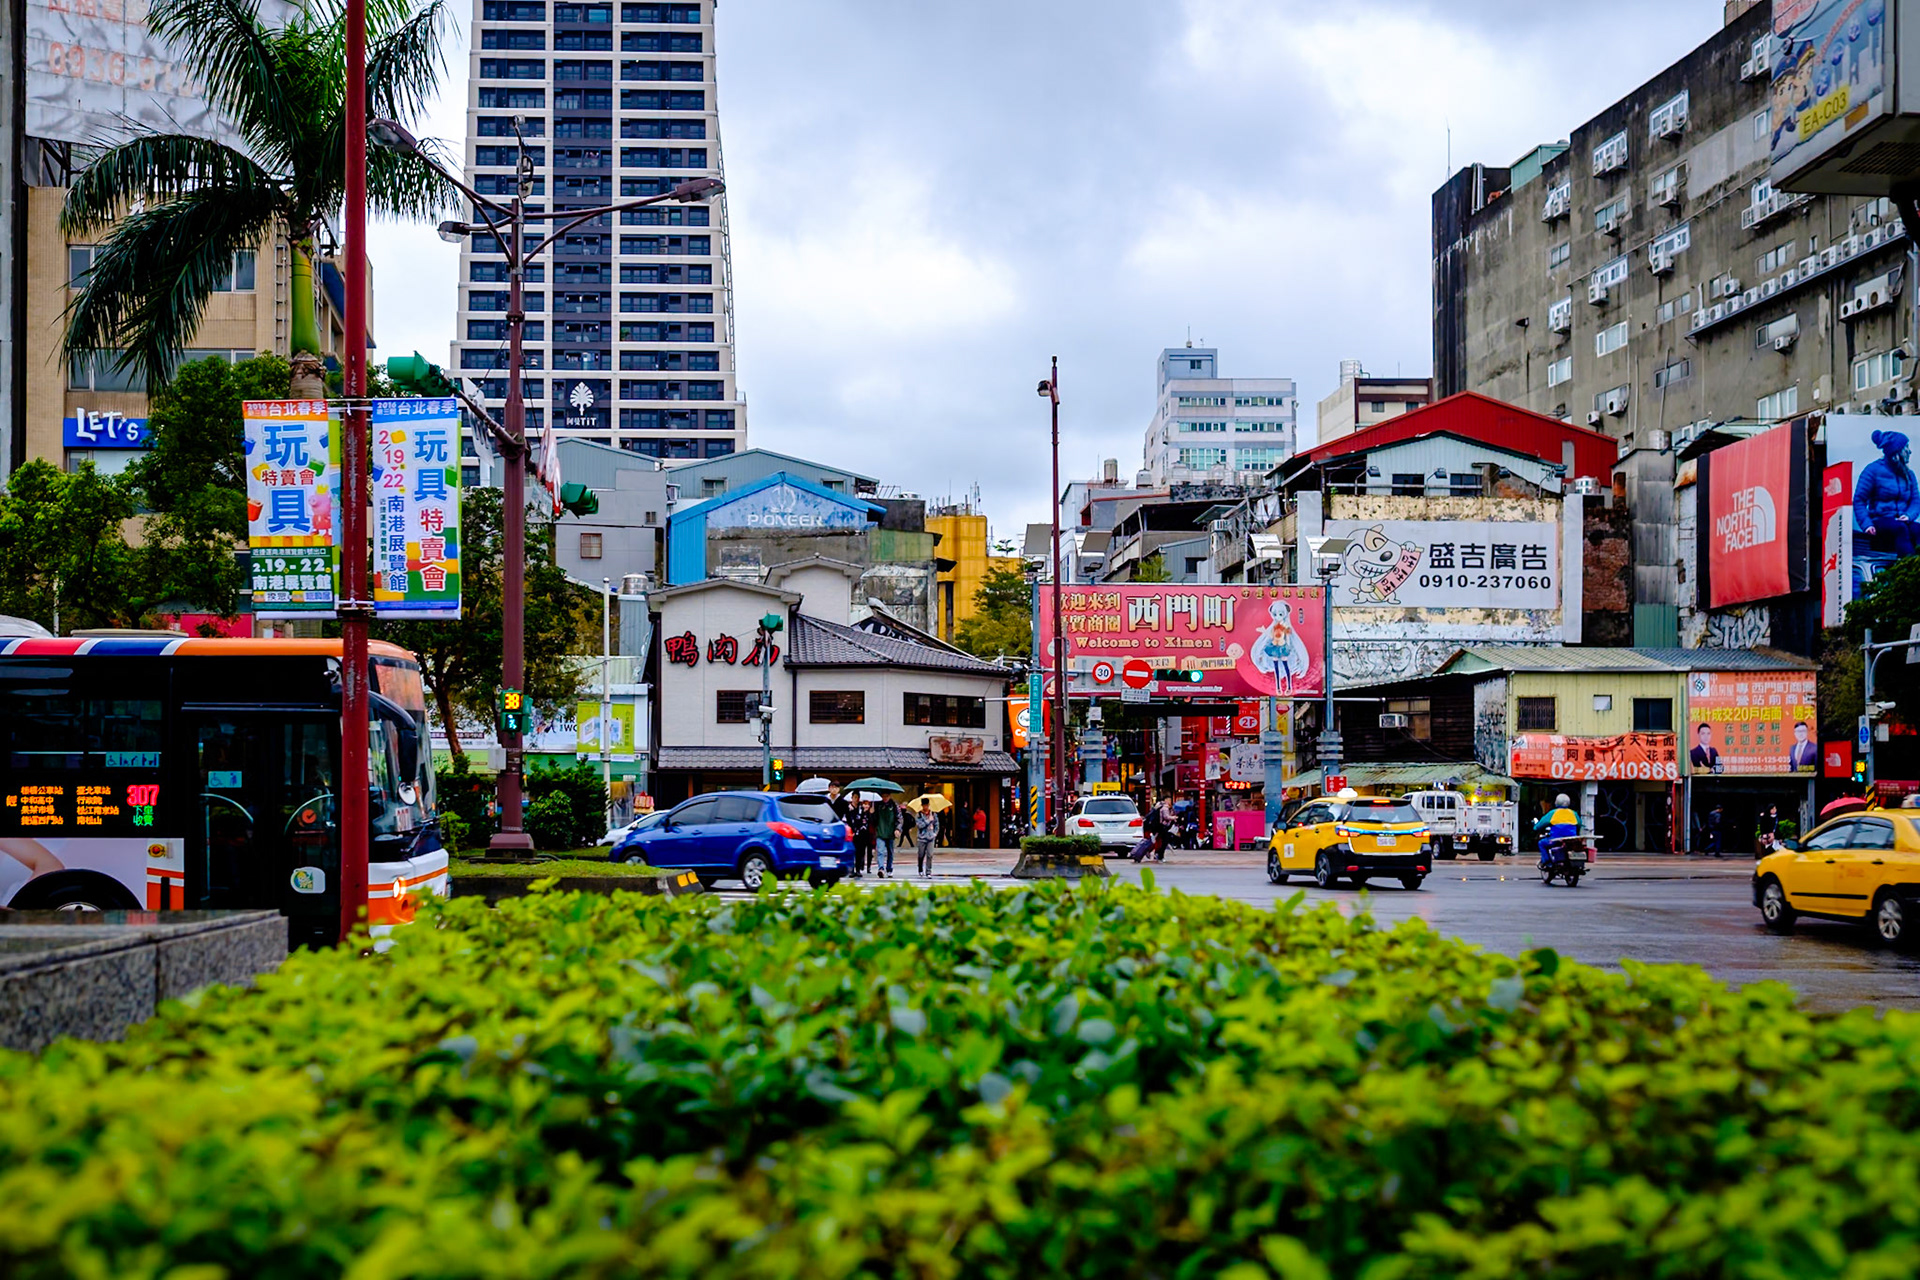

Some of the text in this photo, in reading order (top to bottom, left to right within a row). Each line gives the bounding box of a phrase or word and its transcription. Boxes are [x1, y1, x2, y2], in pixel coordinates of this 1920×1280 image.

[1803, 91, 1847, 135] EA-C03
[269, 401, 326, 417] 台北春季
[398, 400, 456, 416] 台北春季
[264, 424, 309, 468] 玩
[261, 469, 315, 486] 特賣會
[383, 474, 404, 488] 22
[1732, 488, 1754, 511] THE
[267, 489, 311, 533] 具
[747, 513, 825, 527] PIONEER
[1716, 508, 1752, 537] NORTH
[387, 495, 408, 592] 南港展覽館
[1724, 529, 1753, 554] FACE
[1428, 543, 1547, 571] 盛吉廣告
[252, 575, 332, 590] 南港展覽館
[1419, 574, 1551, 590] 0910-237060
[1126, 593, 1237, 632] 西門町
[1075, 636, 1139, 648] Welcome
[1145, 637, 1159, 648] to
[1164, 637, 1212, 648] Ximen
[1097, 668, 1110, 678] 30
[504, 692, 521, 710] 38
[1241, 717, 1257, 728] 2F
[1551, 761, 1678, 780] 02-23410366
[126, 784, 160, 807] 307
